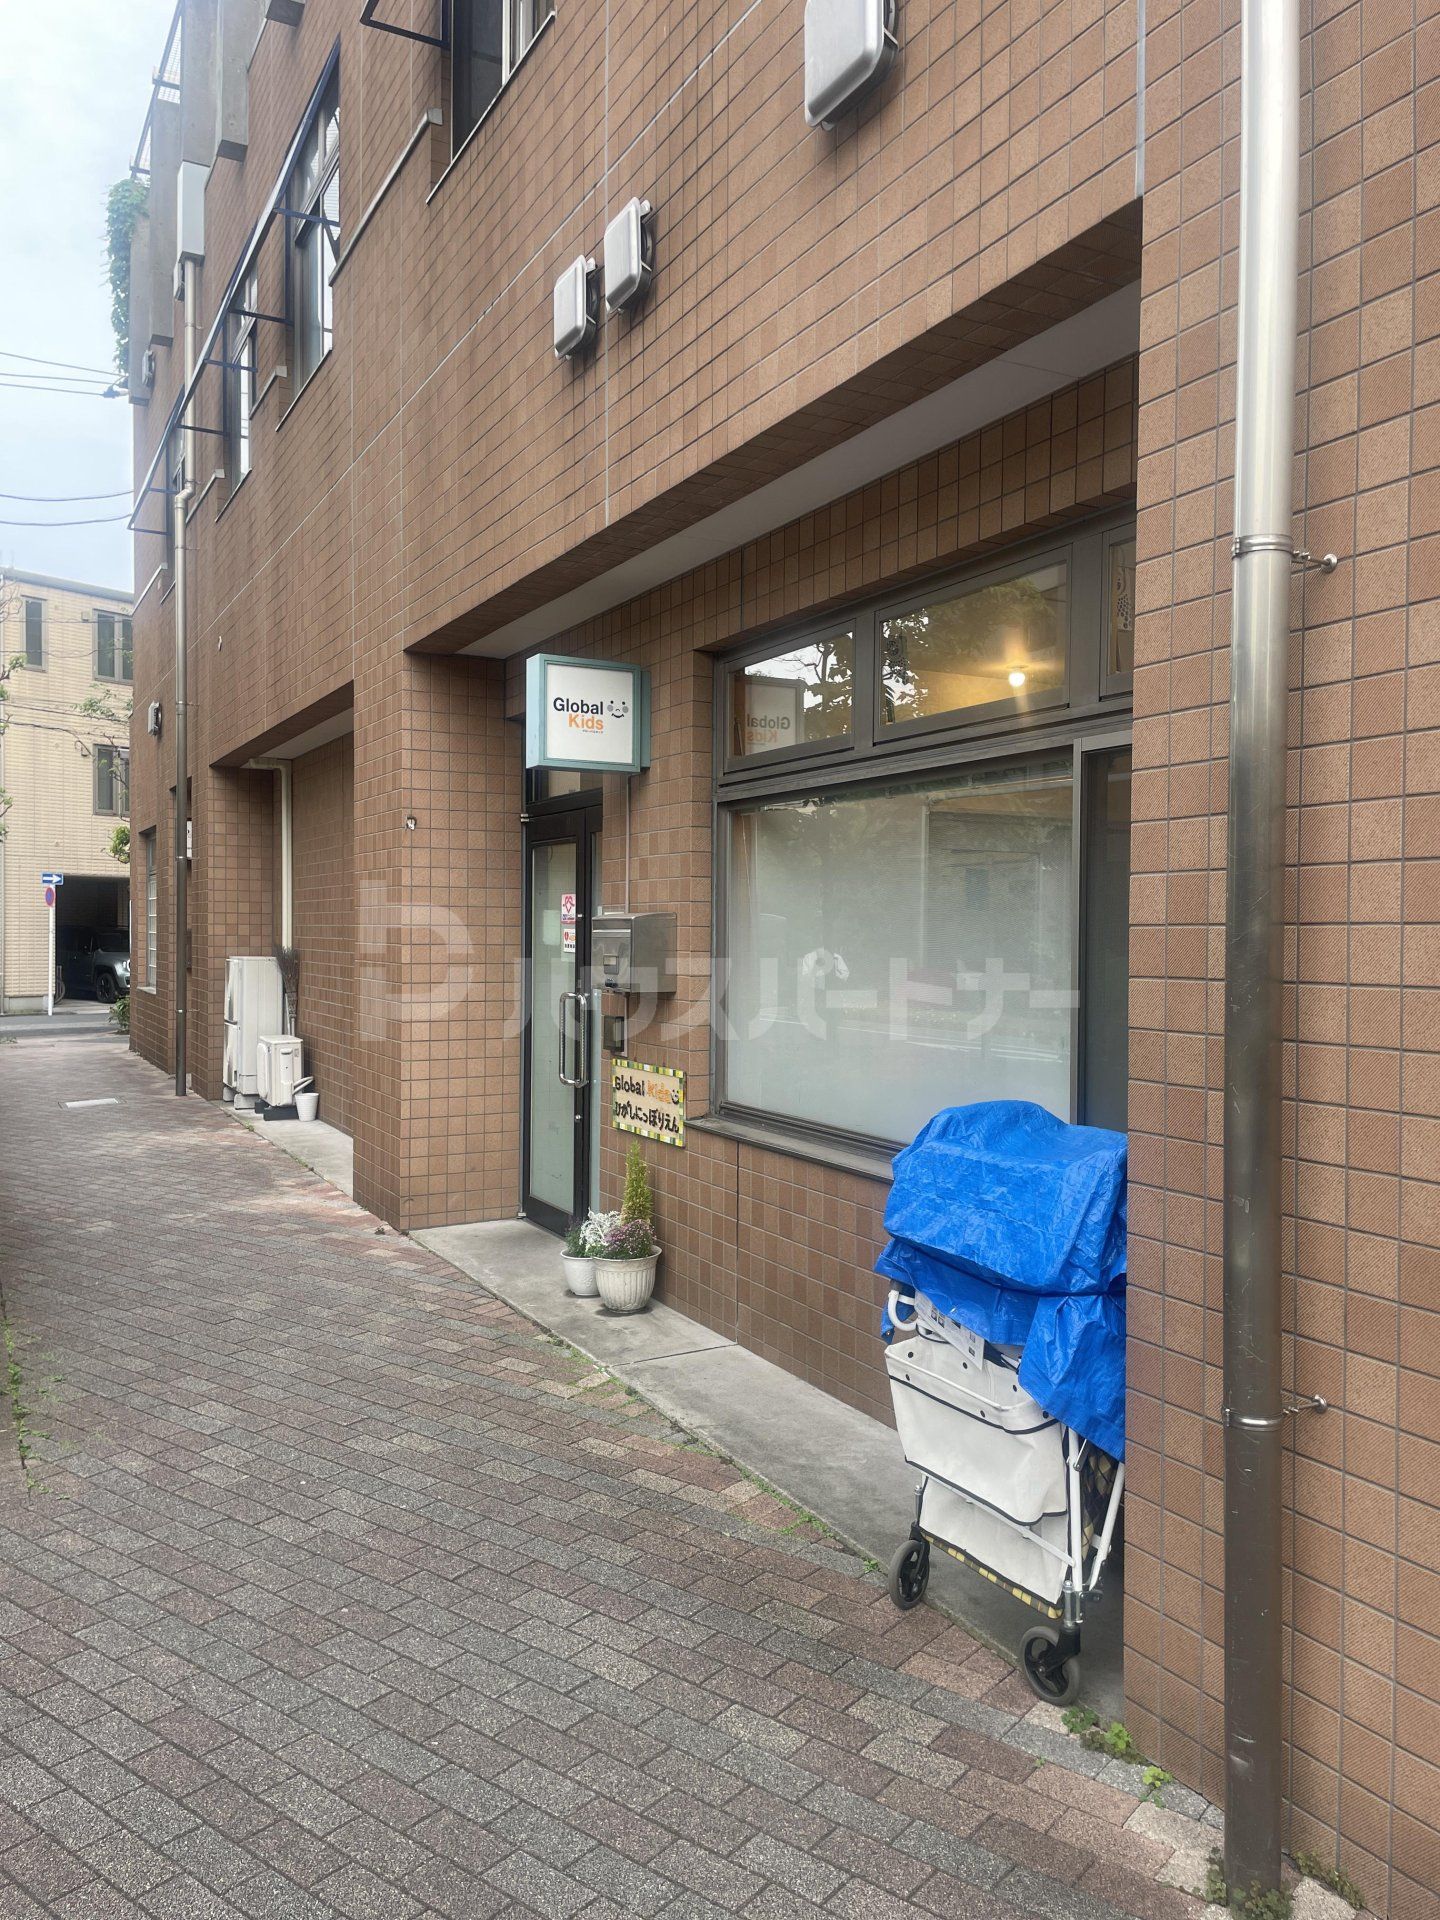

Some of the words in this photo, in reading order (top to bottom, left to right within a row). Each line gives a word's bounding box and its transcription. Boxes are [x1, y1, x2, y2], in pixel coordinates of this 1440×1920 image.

[553, 697, 604, 715] Global
[568, 713, 604, 731] Kids
[615, 1074, 645, 1096] Global
